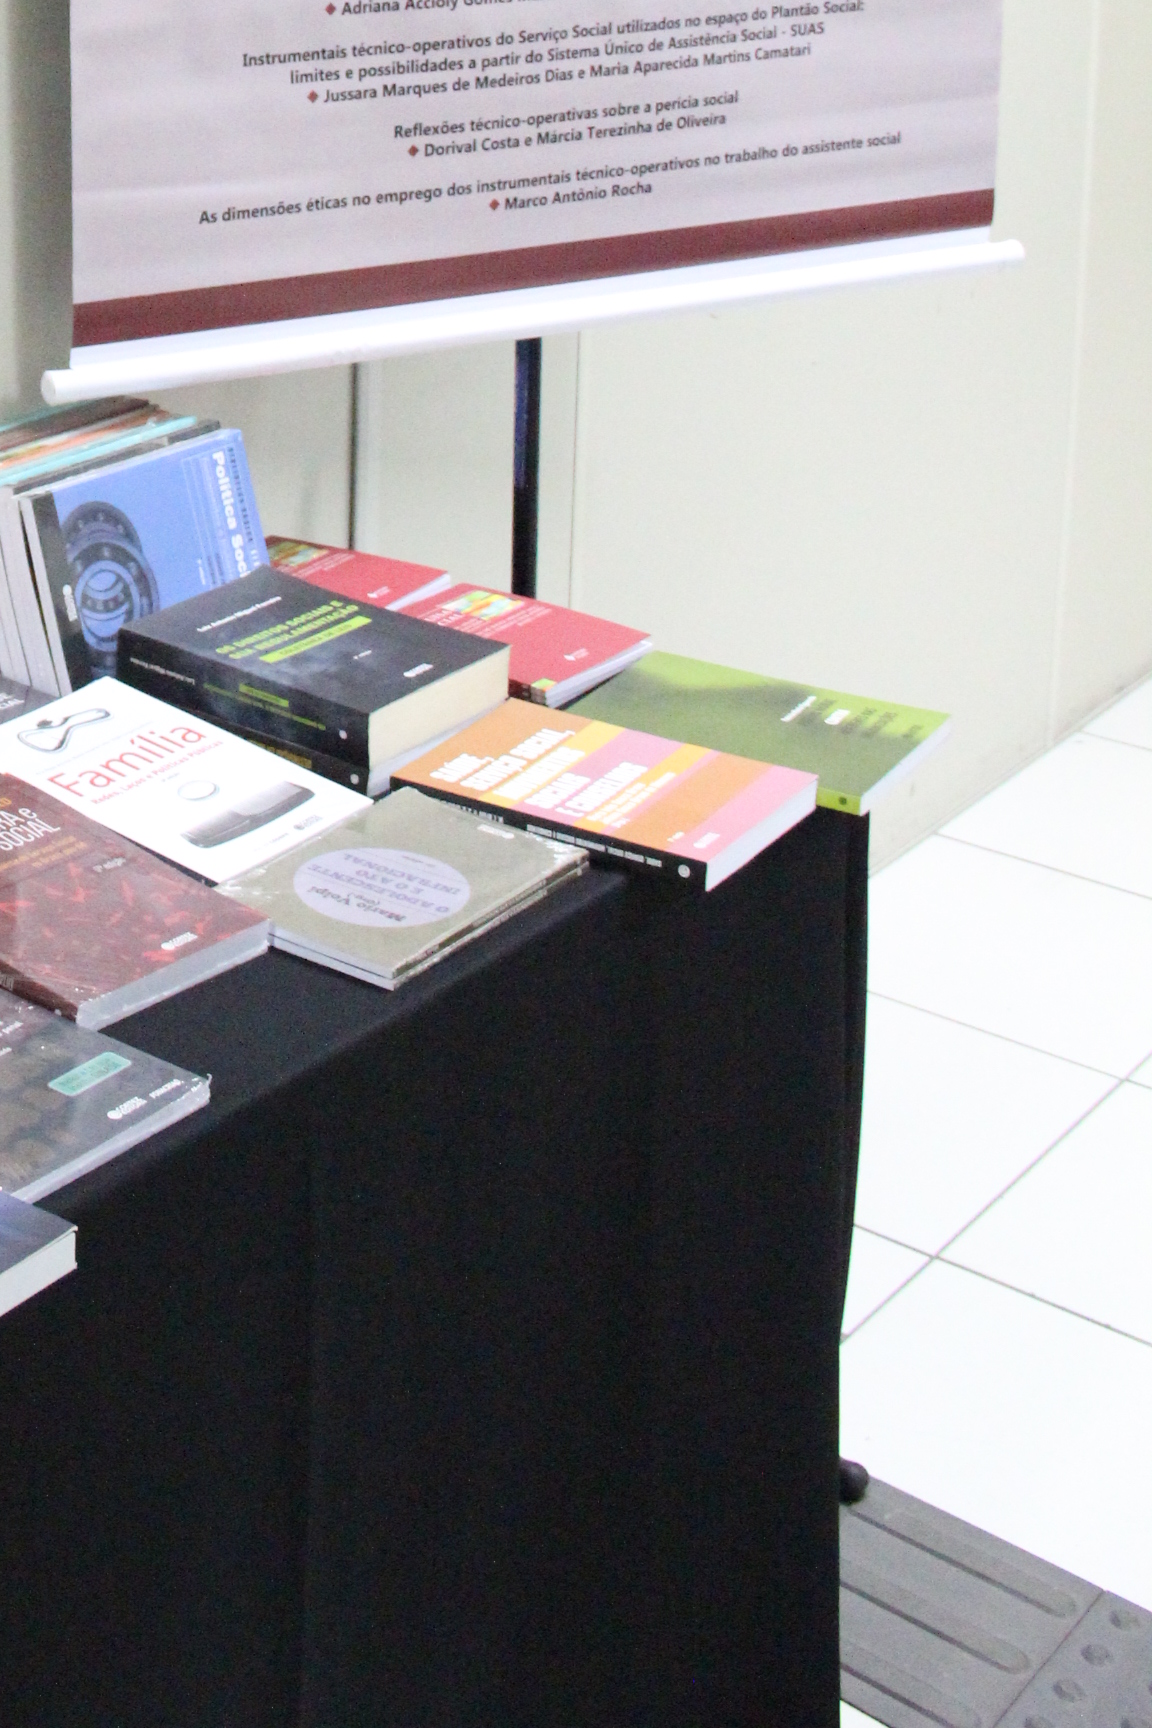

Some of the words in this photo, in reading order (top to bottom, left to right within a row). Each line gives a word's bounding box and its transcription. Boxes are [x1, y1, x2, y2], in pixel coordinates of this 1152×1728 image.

[322, 87, 378, 101] Jussara
[381, 81, 448, 98] Marques
[451, 76, 471, 91] de
[474, 72, 541, 89] Medeiros
[544, 68, 574, 83] Dias
[576, 69, 586, 80] e
[588, 62, 629, 79] Maria
[632, 55, 699, 77] Aparecida
[702, 51, 751, 68] Martins
[753, 43, 811, 62] Camatari
[47, 726, 207, 798] Família
[17, 807, 38, 820] e
